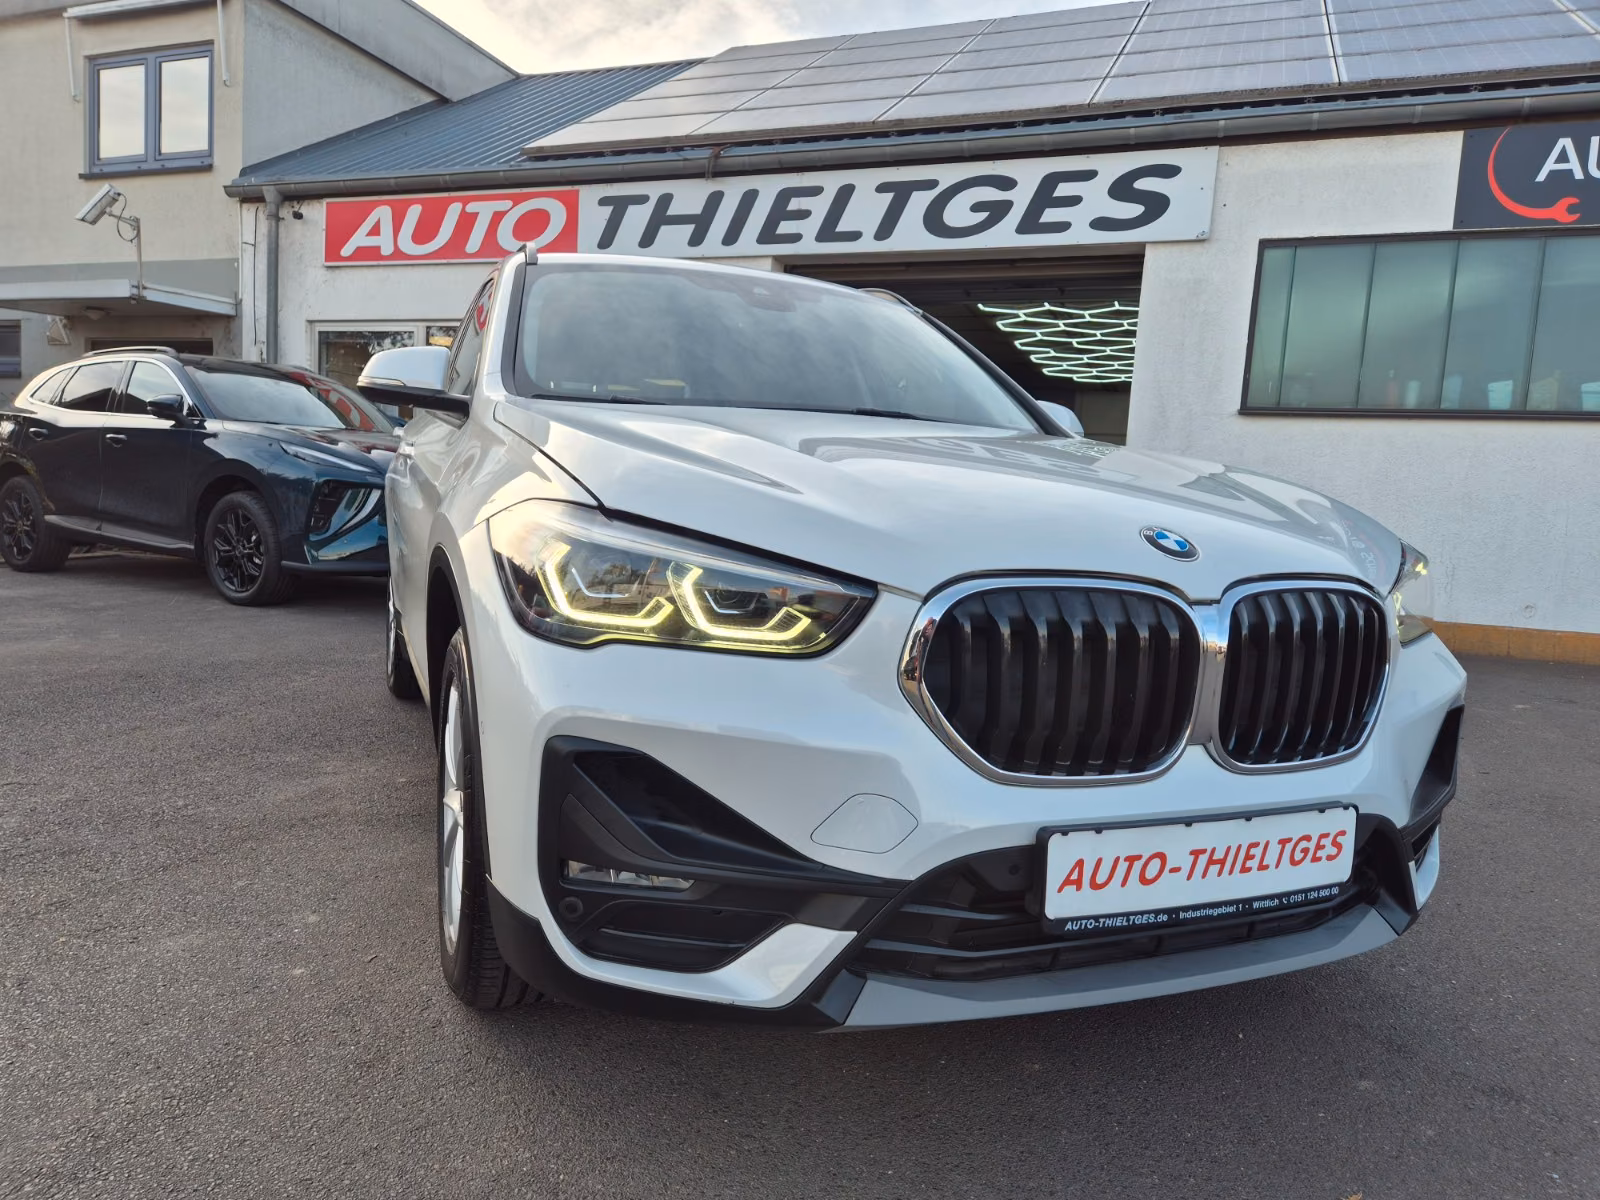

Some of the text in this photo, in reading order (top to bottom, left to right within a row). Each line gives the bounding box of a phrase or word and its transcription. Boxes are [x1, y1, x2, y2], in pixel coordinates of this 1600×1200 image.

[340, 163, 1183, 257] AUTO THIELTGES
[1057, 830, 1347, 893] AUTO-THIELTGES
[1065, 913, 1168, 931] AUTO-THIELTGES.de
[1179, 905, 1237, 919] Industriegebiet
[1252, 898, 1280, 910] Wittlich
[1289, 893, 1306, 903] 0151
